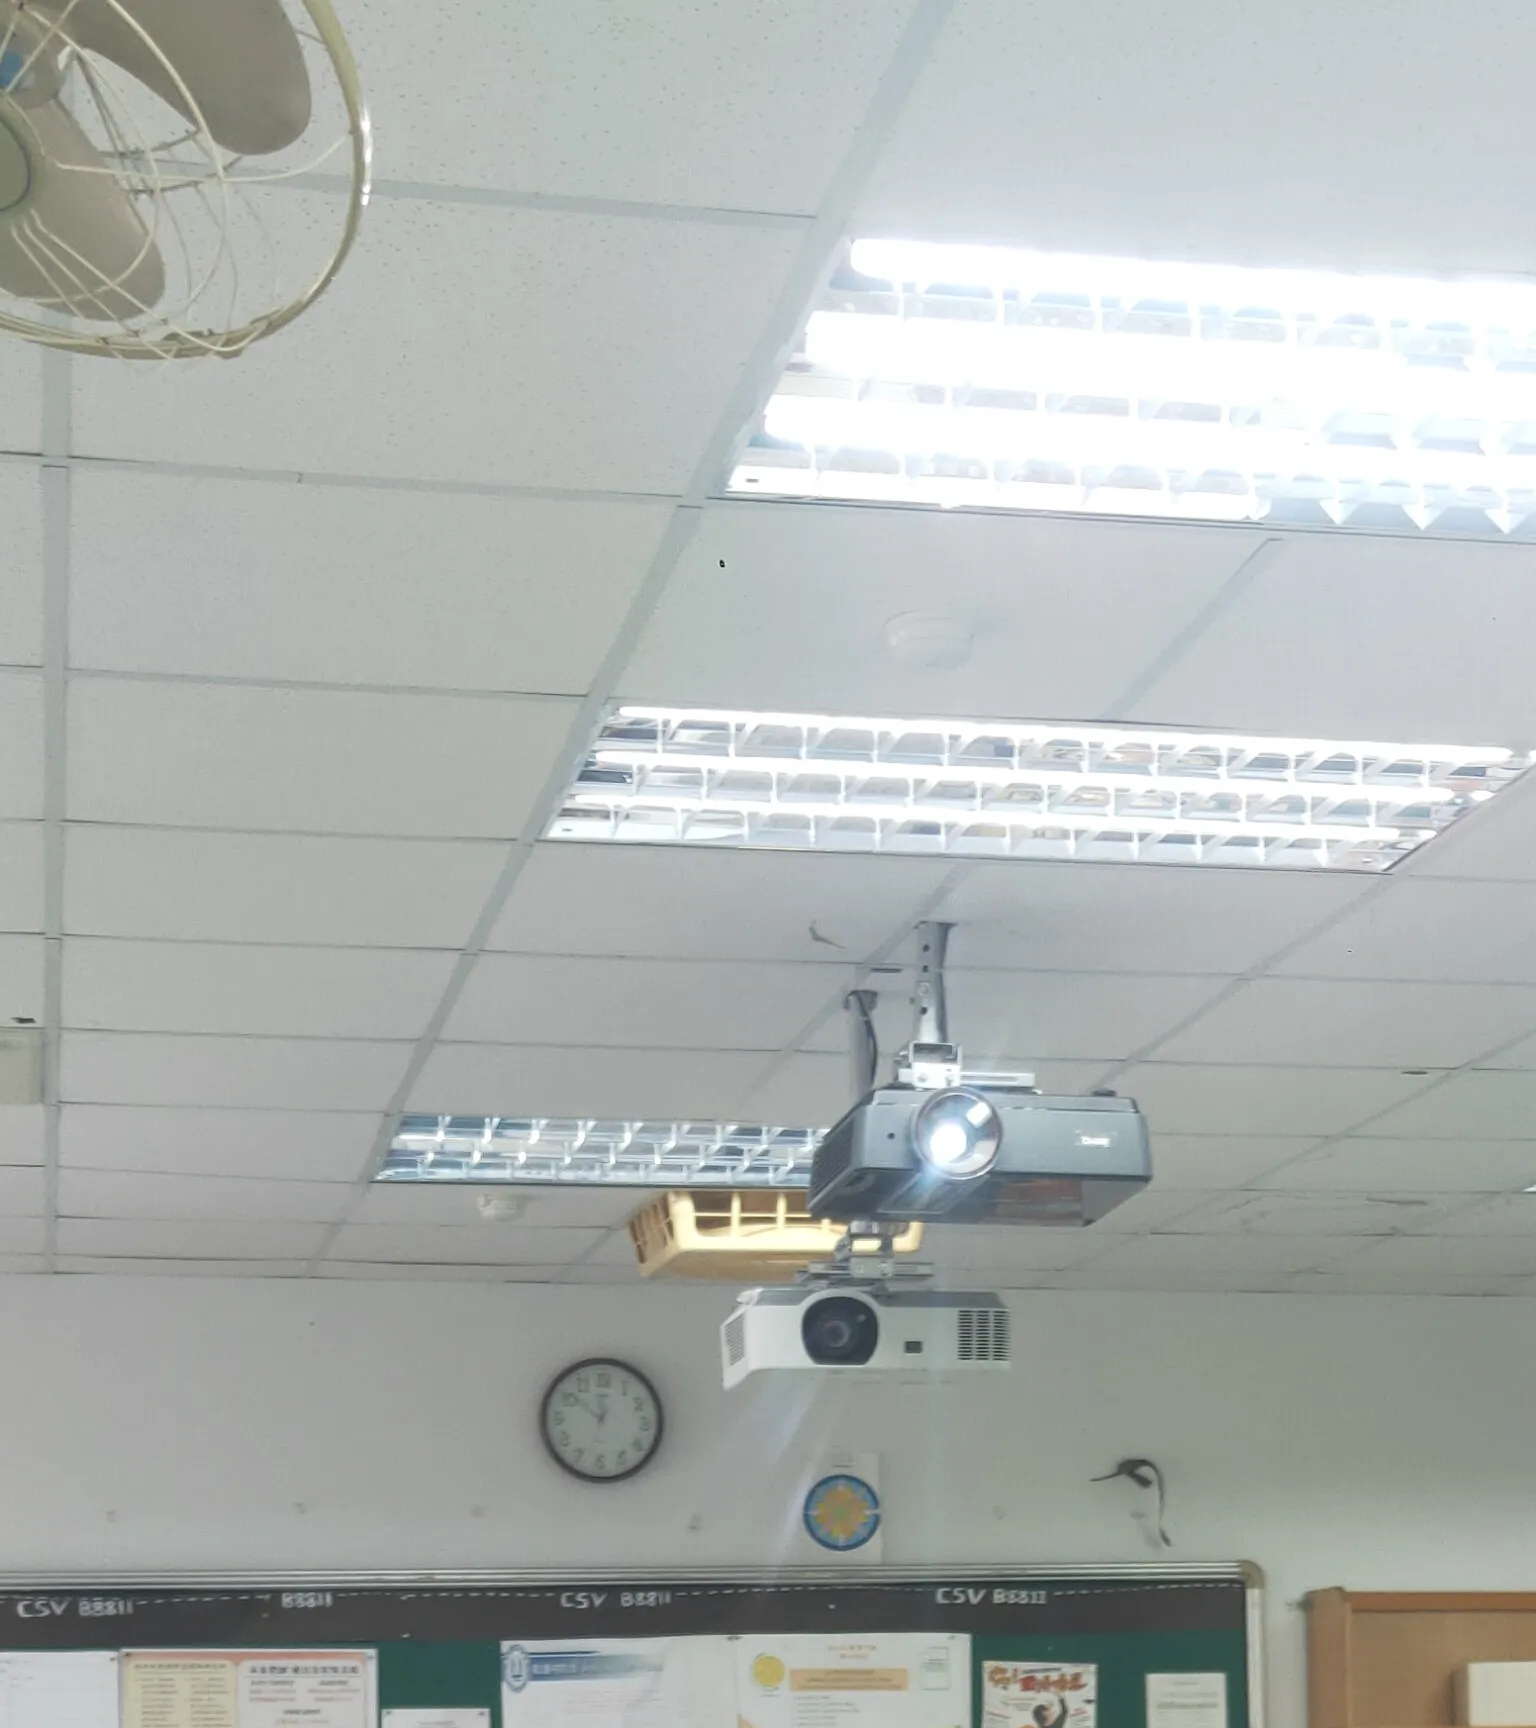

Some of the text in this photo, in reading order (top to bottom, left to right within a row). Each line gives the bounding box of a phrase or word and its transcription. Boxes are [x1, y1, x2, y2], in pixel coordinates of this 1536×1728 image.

[560, 1592, 608, 1609] CSV
[935, 1587, 986, 1605] CSV
[16, 1598, 70, 1618] CSV
